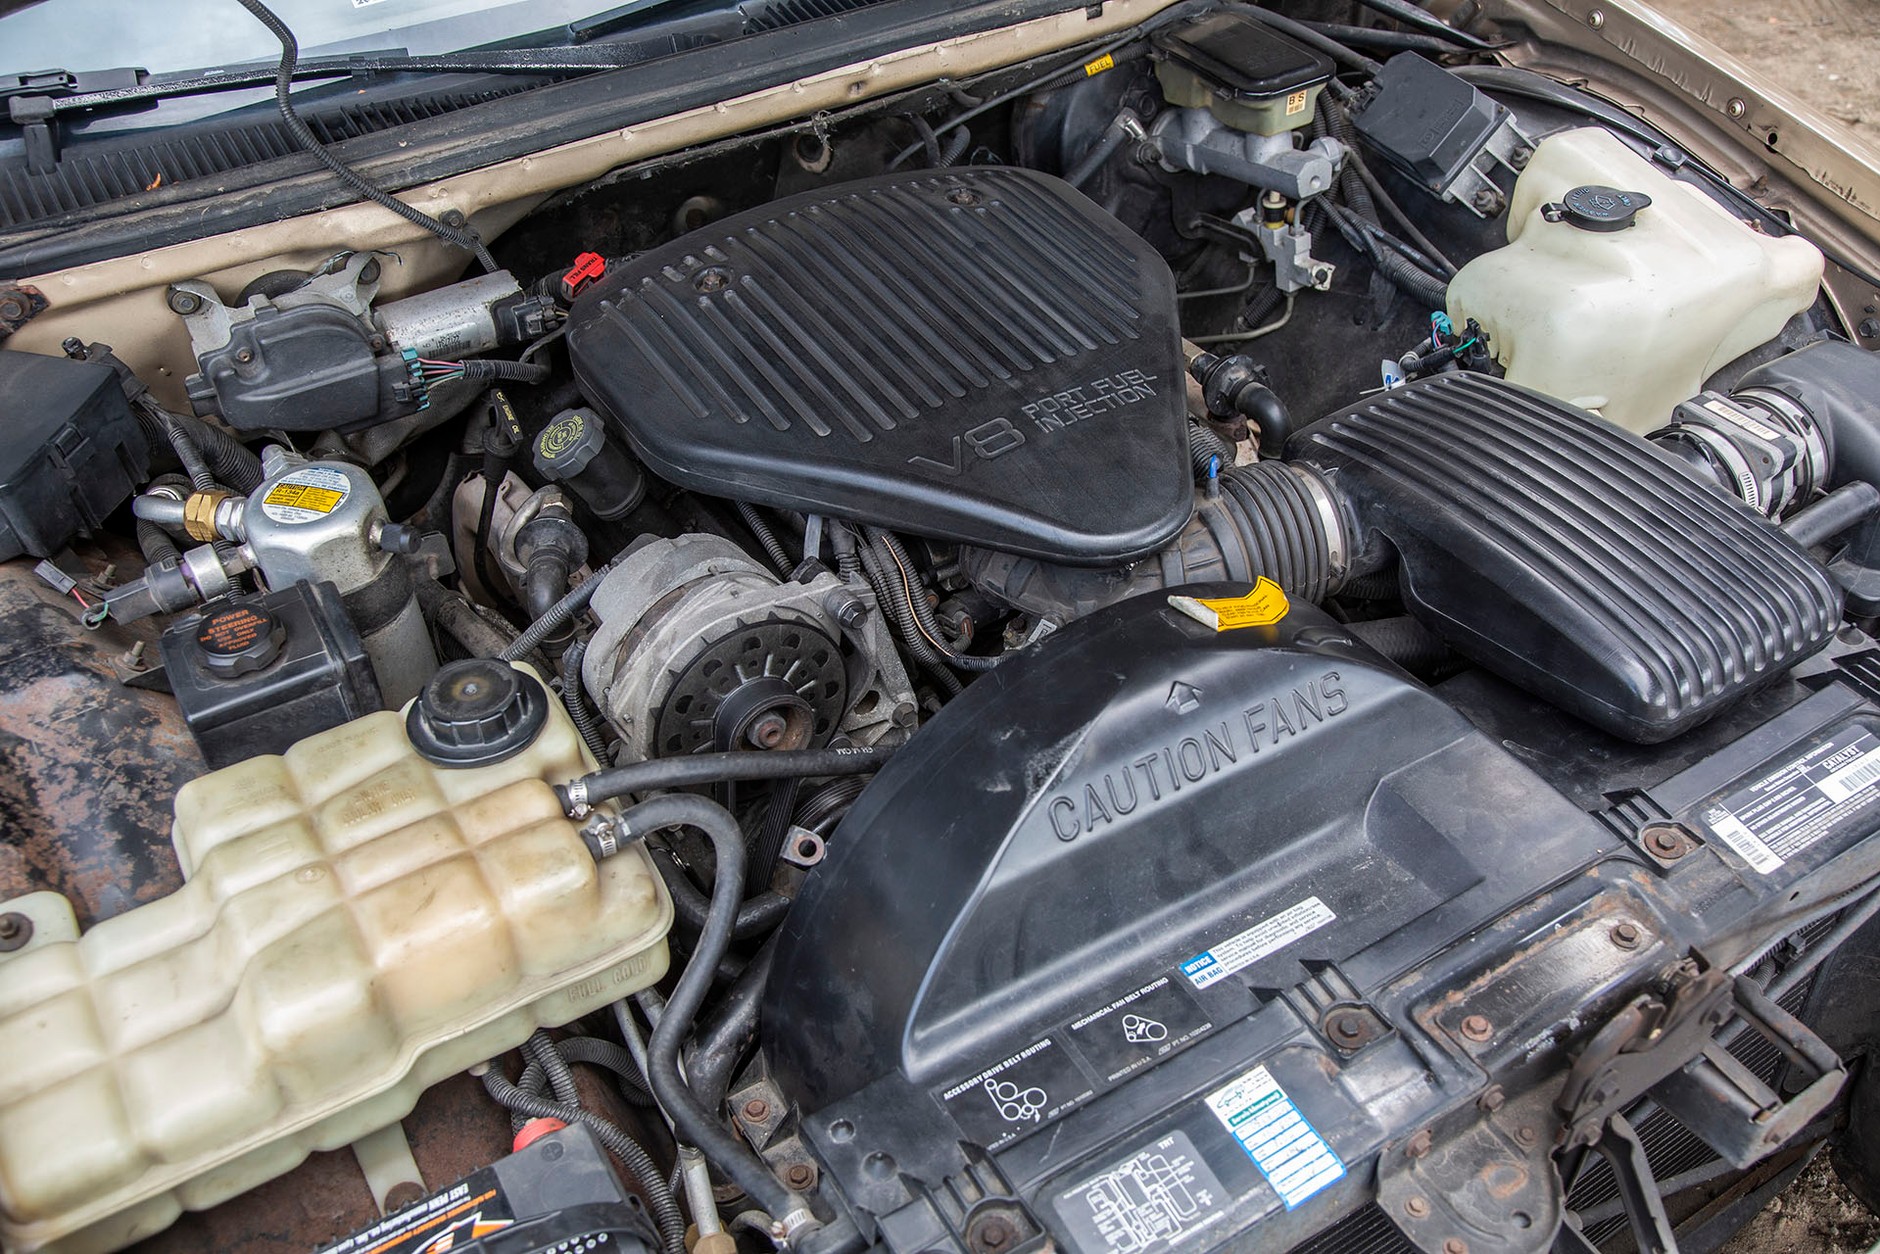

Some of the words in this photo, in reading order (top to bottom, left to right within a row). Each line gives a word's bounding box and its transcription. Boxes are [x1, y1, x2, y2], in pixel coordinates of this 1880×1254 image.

[1090, 60, 1110, 73] FUEL
[1289, 96, 1295, 105] B
[1298, 92, 1304, 102] S
[1021, 386, 1087, 419] PORT
[1091, 369, 1158, 394] FUEL
[1034, 384, 1156, 433] INJECTION
[908, 417, 1026, 475] V8
[208, 615, 257, 634] STEERING
[212, 609, 248, 625] POWER
[234, 618, 268, 632] OVERFILL
[219, 632, 257, 648] APPROVED
[237, 628, 254, 636] ONLY
[228, 640, 250, 650] FLUID
[1048, 721, 1237, 842] CAUTION
[1243, 671, 1348, 753] FANS
[1822, 745, 1860, 770] CATALYST
[1184, 956, 1212, 974] NOTICE
[1194, 975, 1208, 985] AIR
[1208, 967, 1224, 978] BAG
[1071, 1006, 1113, 1030] MECHANICAL
[1112, 999, 1125, 1010] FAN
[1124, 991, 1140, 1003] BELT
[1140, 977, 1168, 995] ROUTING
[944, 1076, 984, 1100] ACCESSORY
[982, 1064, 1004, 1080] DRIVE
[1002, 1055, 1022, 1068] BELT
[1020, 1038, 1052, 1059] ROUTING
[1108, 1067, 1132, 1082] PRINTED
[1157, 1136, 1175, 1150] TRT
[448, 1183, 469, 1200] EAST
[428, 1193, 449, 1212] PENN
[380, 1204, 428, 1232] manufacturing
